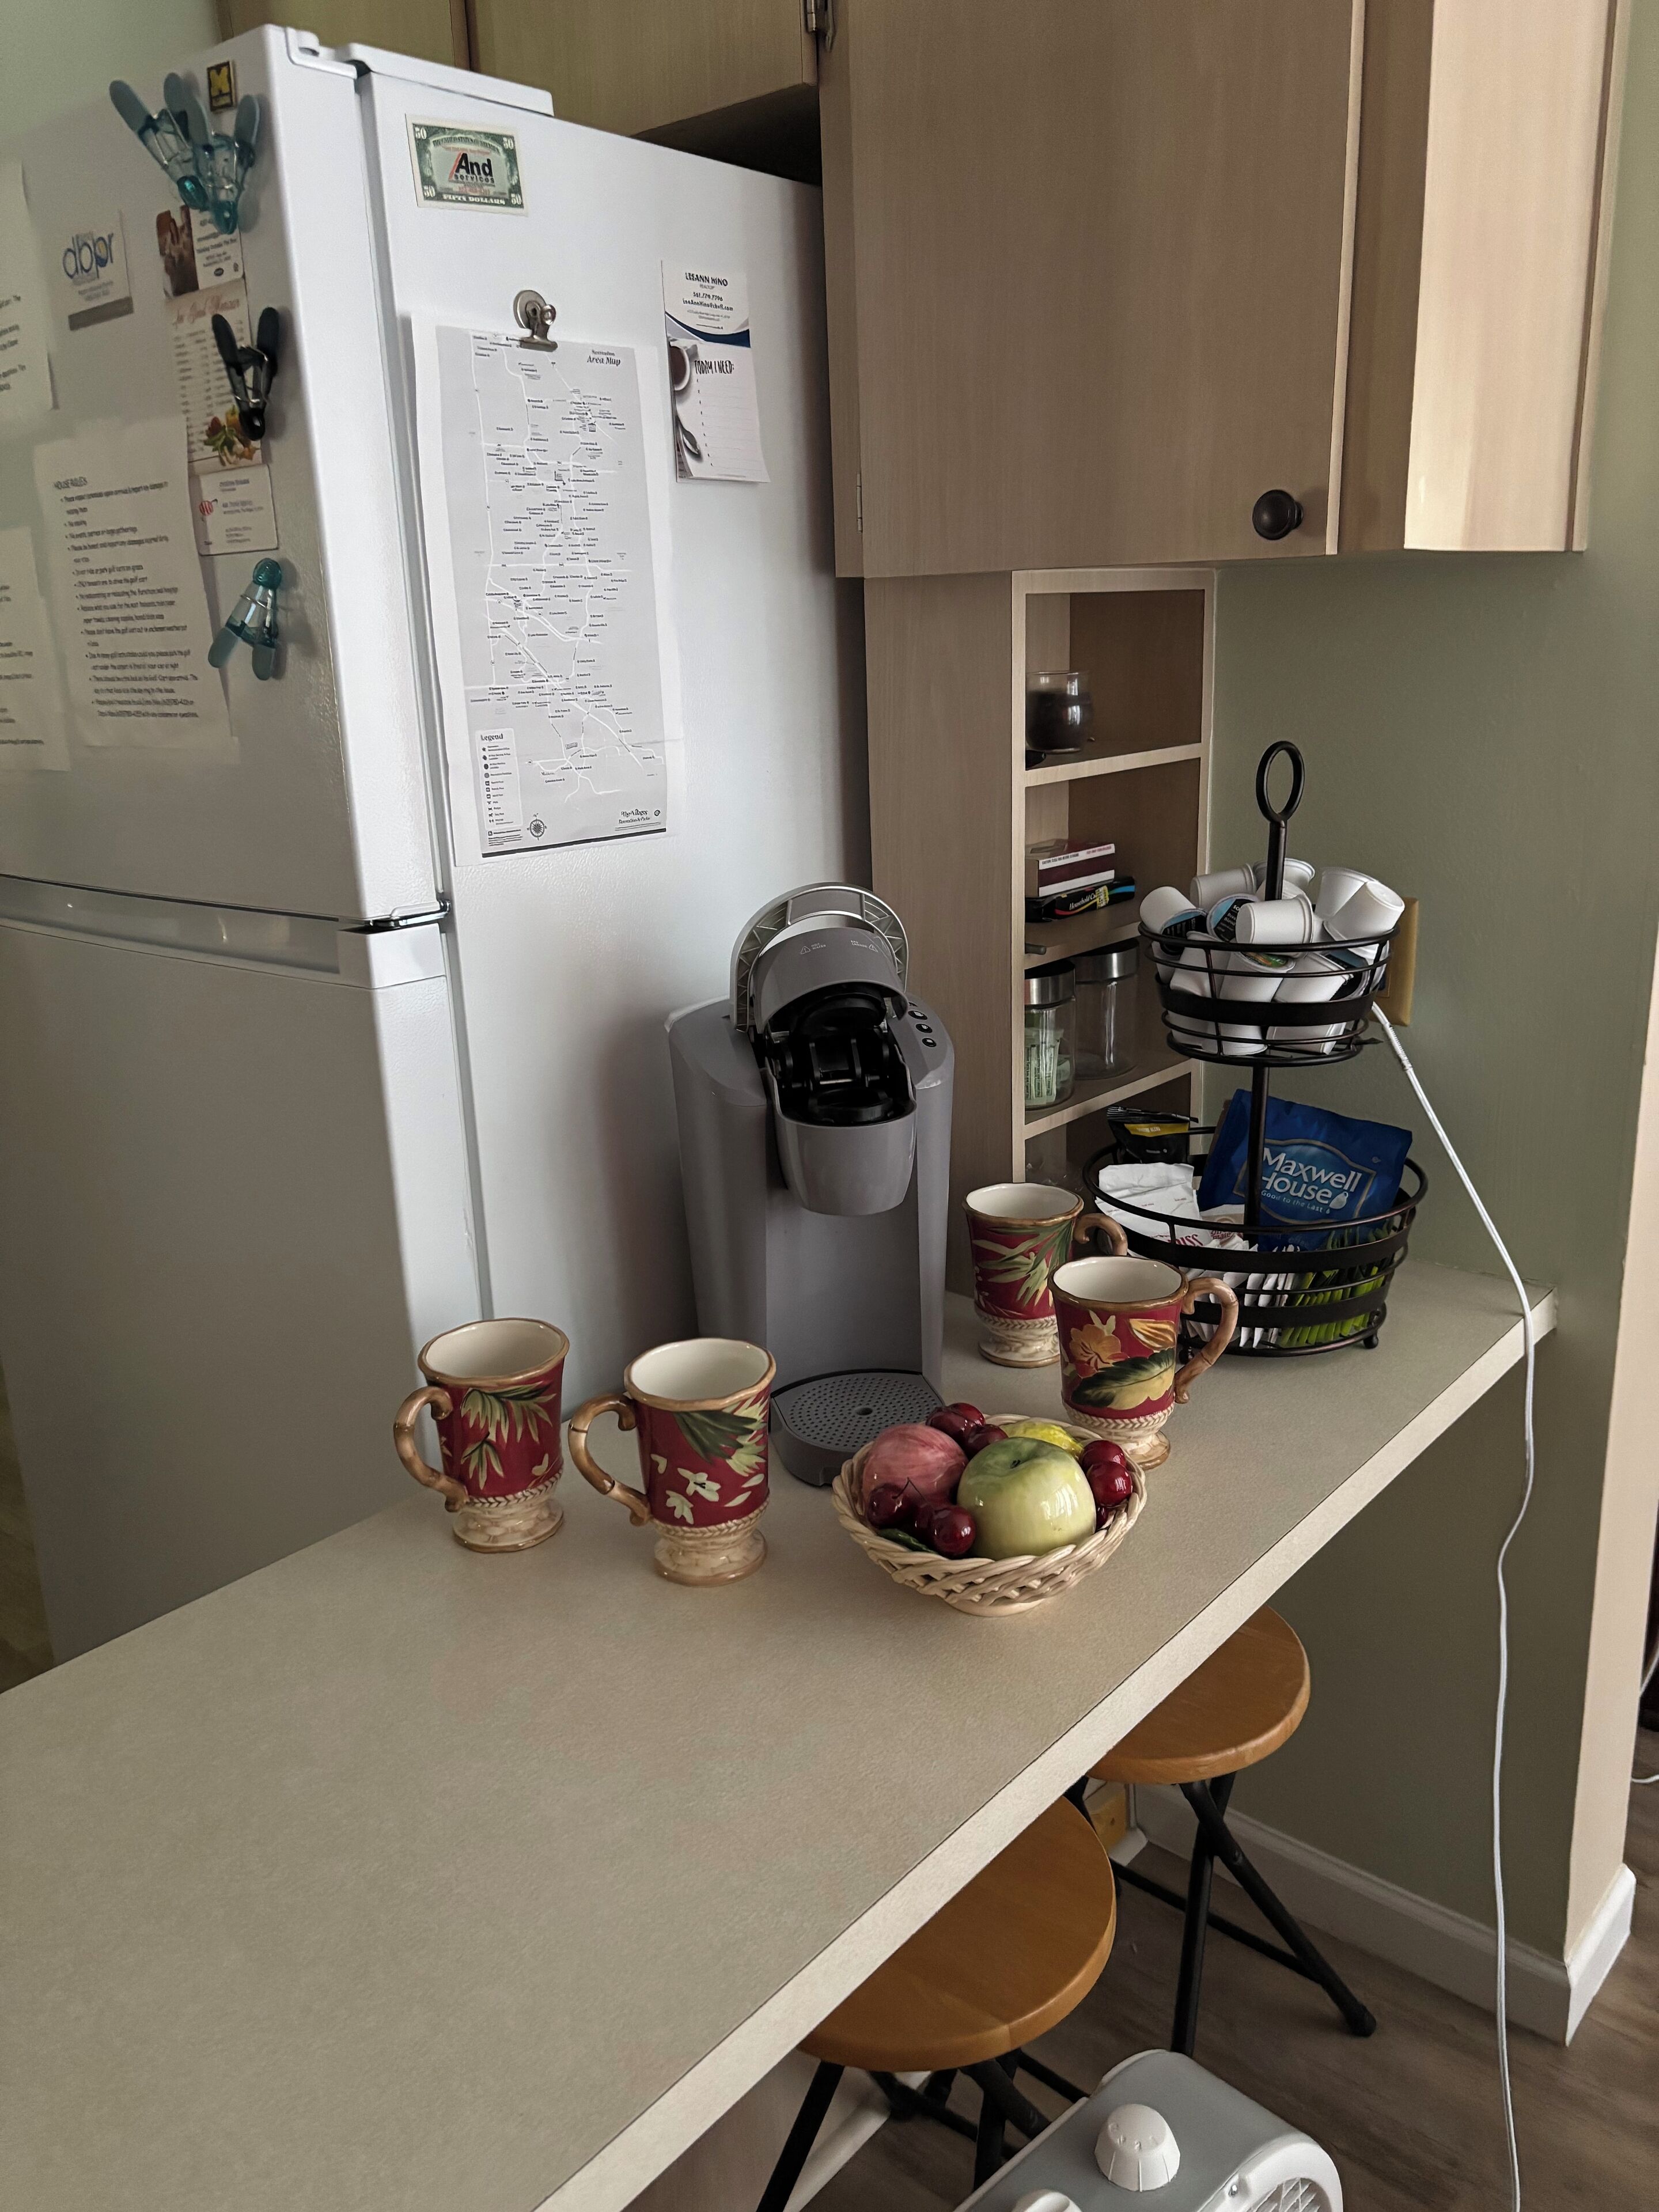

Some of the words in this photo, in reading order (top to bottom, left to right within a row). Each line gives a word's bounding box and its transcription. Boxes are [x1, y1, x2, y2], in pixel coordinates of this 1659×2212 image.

[414, 127, 427, 139] 50
[455, 152, 493, 177] And
[454, 173, 495, 184] services
[423, 185, 436, 198] 50
[586, 355, 604, 364] Area
[605, 357, 622, 367] Map
[694, 360, 714, 375] TODAY
[714, 361, 717, 373] I
[480, 733, 503, 742] Legend
[1263, 1147, 1362, 1192] Maxwell
[1262, 1172, 1333, 1204] House
[1261, 1190, 1281, 1201] Good
[1293, 1199, 1306, 1207] the
[1307, 1203, 1323, 1213] Last
